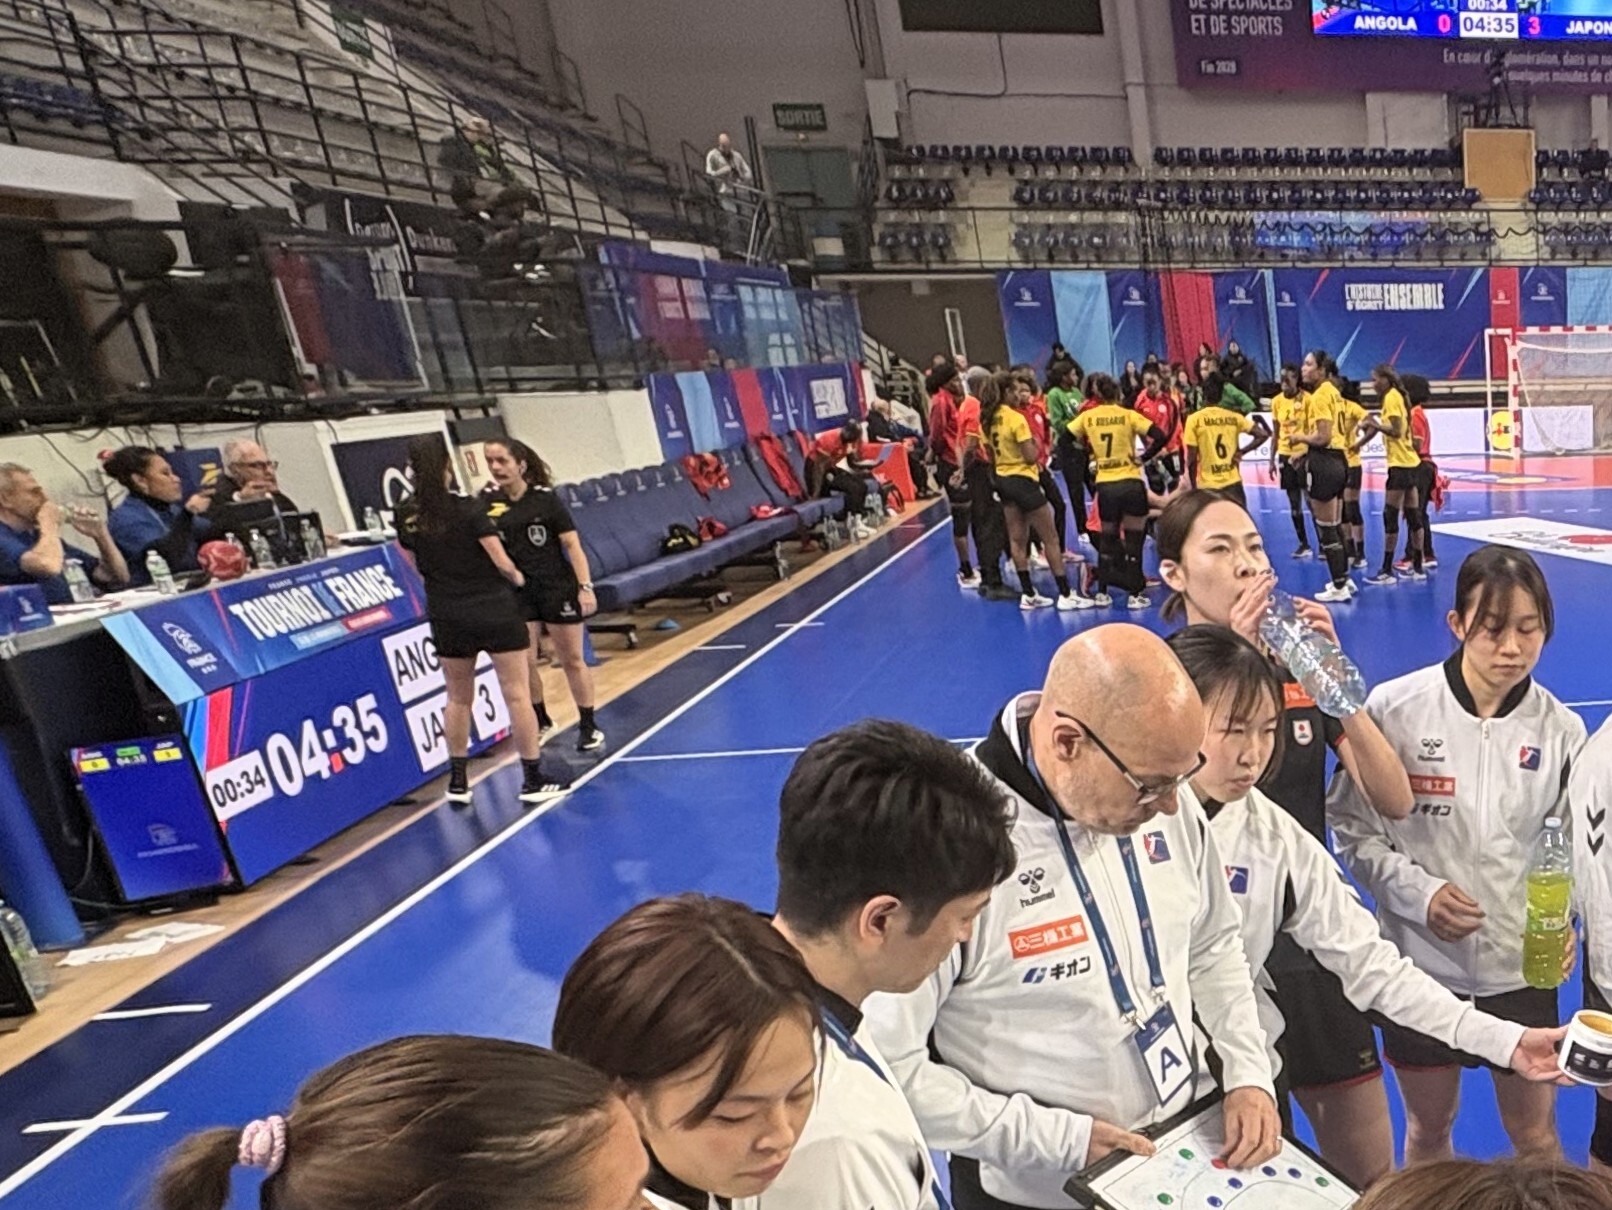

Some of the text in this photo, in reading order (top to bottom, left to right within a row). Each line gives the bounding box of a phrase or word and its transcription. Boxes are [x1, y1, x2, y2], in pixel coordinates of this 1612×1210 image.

[1190, 15, 1284, 36] ET DE SPORTS
[1353, 15, 1418, 32] ANGOLA
[1437, 14, 1451, 33] 0
[1462, 16, 1516, 33] 04:35
[1527, 16, 1541, 35] 3
[776, 110, 823, 126] SORTIE
[1100, 433, 1113, 459] 7
[1214, 434, 1228, 460] 6
[228, 585, 333, 641] TOURNOI
[324, 564, 404, 613] FRANCE
[478, 683, 497, 723] 3
[211, 693, 389, 807] 00:34 04:35
[1019, 887, 1056, 908] hummel
[1049, 955, 1091, 981] ギオン
[1159, 1046, 1182, 1083] A
